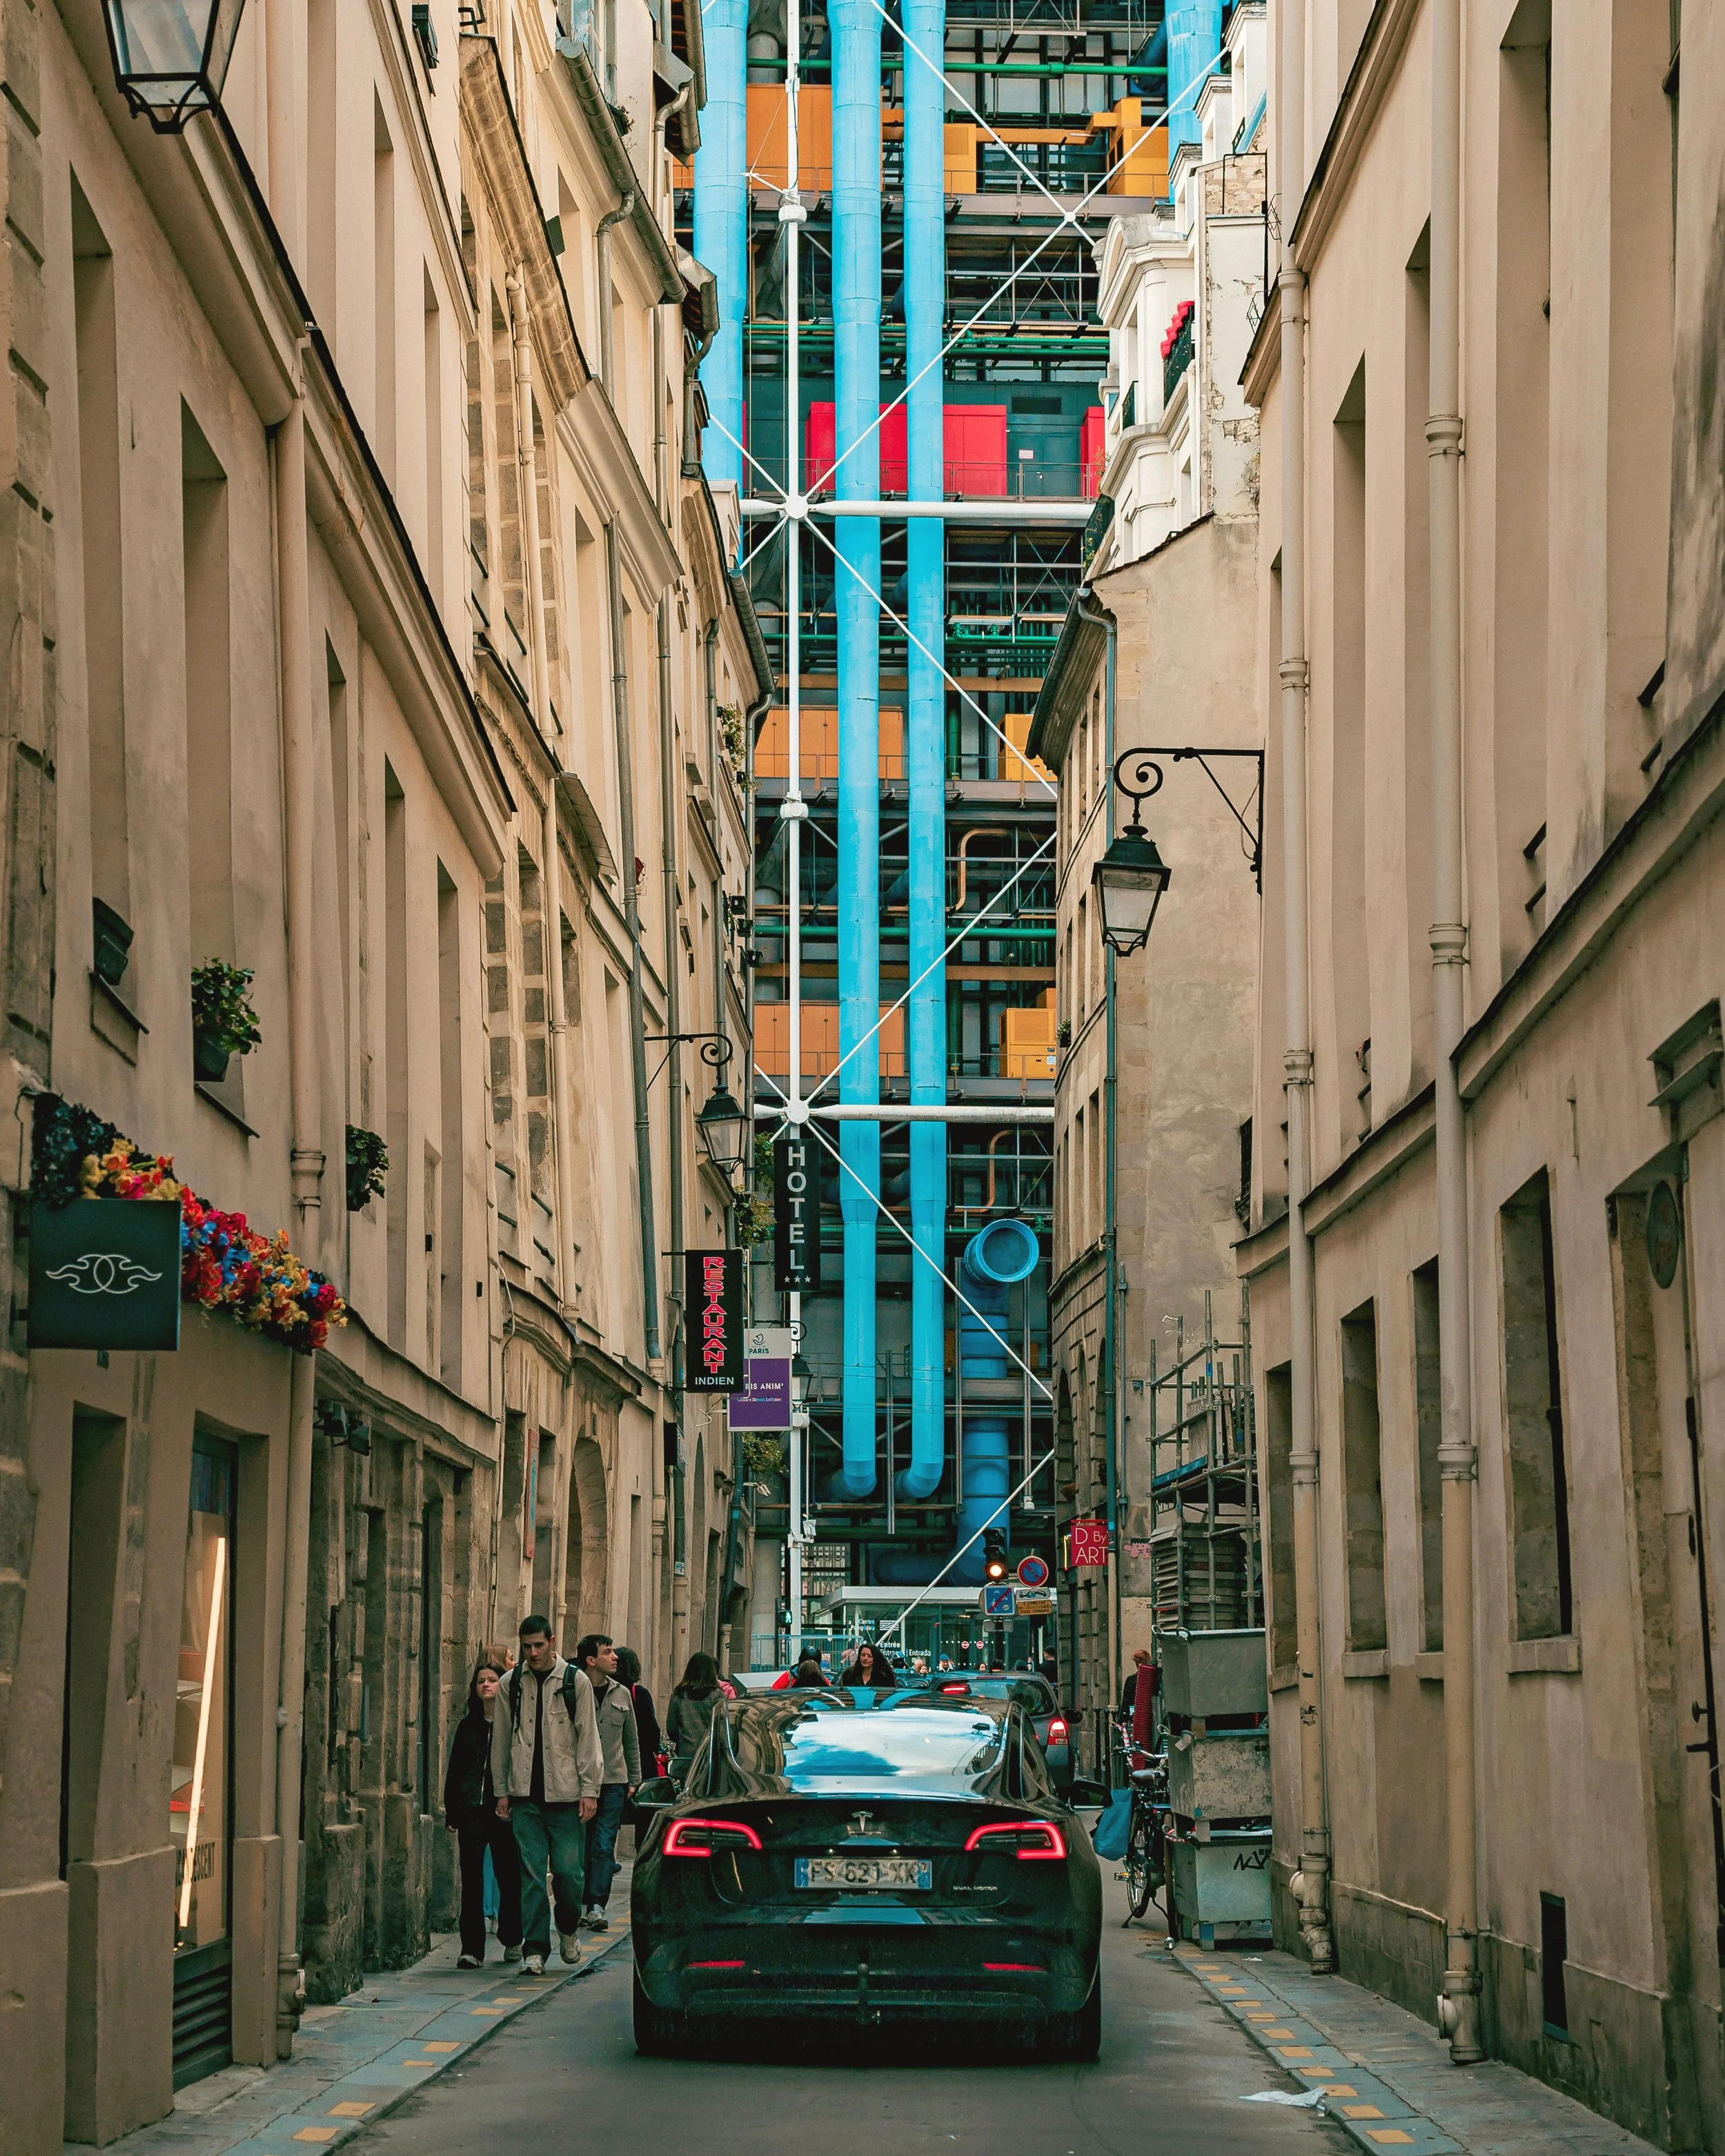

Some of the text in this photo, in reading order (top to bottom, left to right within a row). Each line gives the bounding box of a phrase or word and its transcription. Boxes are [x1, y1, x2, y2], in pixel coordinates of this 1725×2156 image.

[787, 1146, 807, 1269] HOTEL
[702, 1256, 727, 1374] RESTAURANT
[695, 1376, 734, 1385] INDIEN
[1075, 1527, 1107, 1545] D By
[1075, 1546, 1109, 1563] ART
